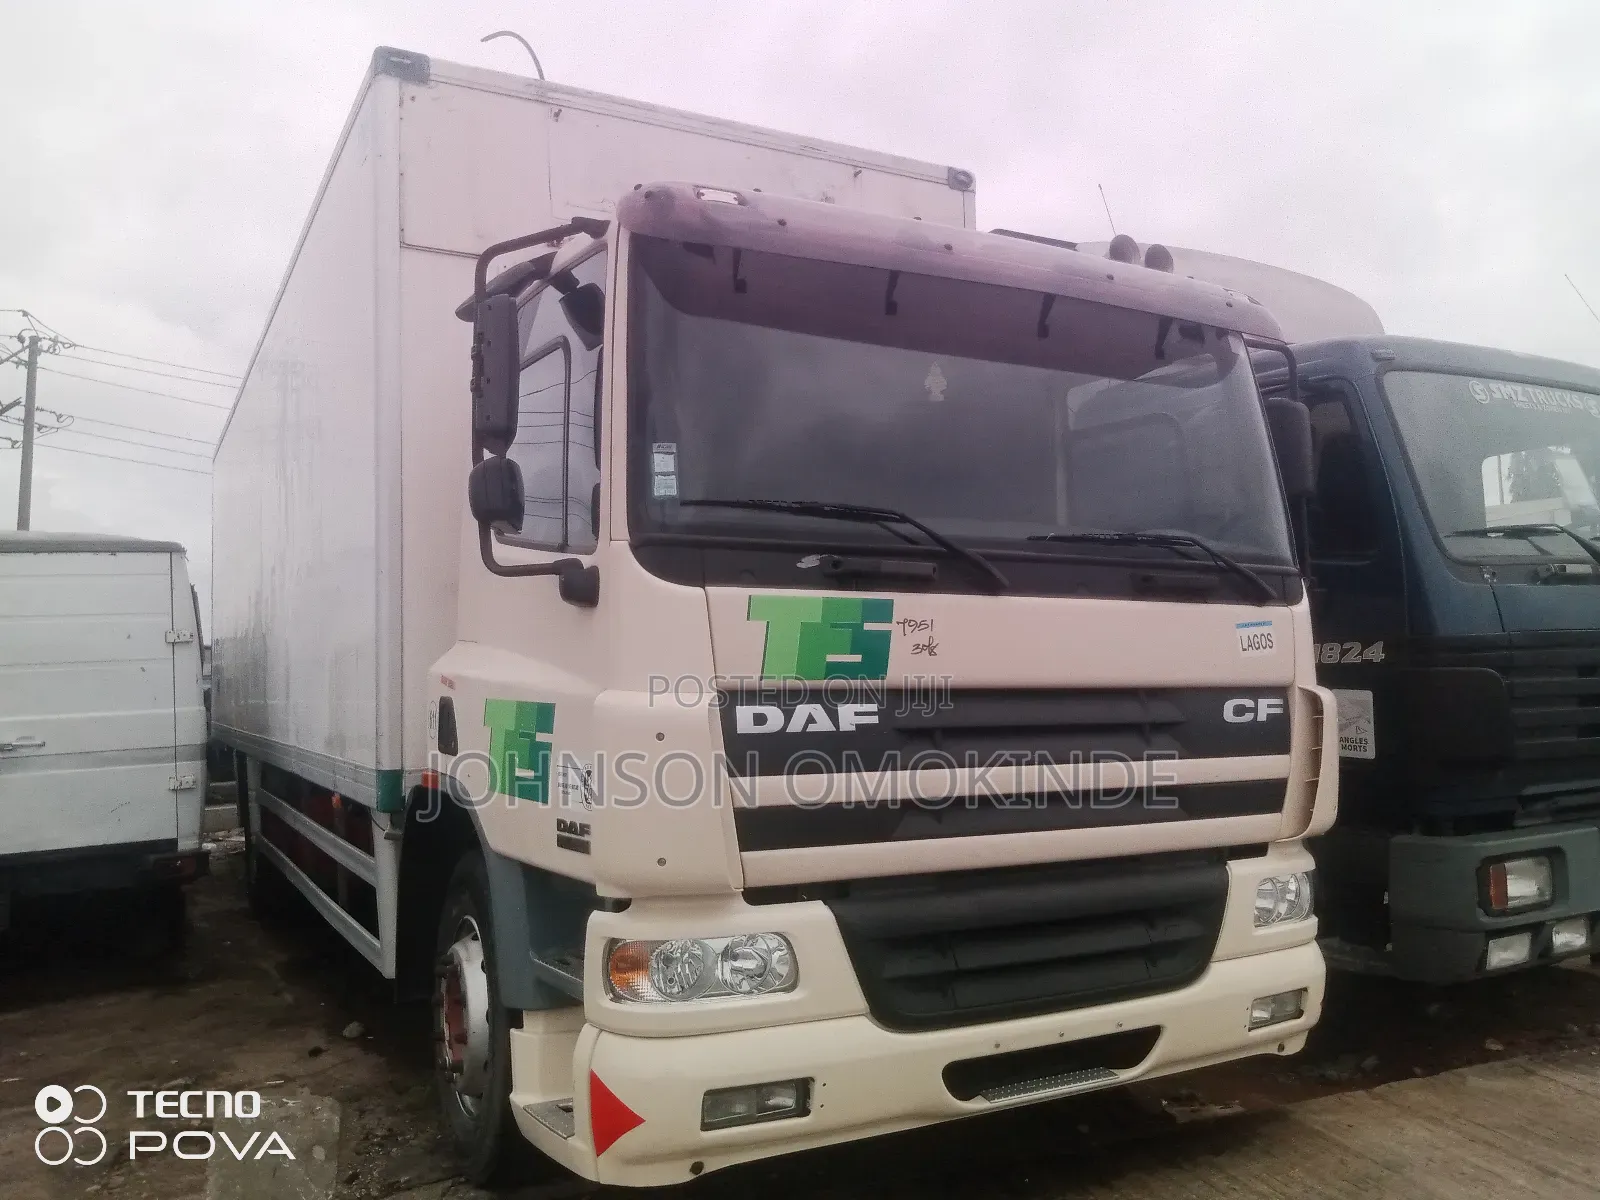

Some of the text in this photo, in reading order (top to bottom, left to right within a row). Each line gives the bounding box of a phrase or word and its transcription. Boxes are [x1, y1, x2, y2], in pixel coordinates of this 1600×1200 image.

[1525, 387, 1583, 409] TRUCKS
[1240, 632, 1274, 651] LAGOS
[1313, 641, 1385, 664] 1824
[736, 703, 879, 734] DAF
[1223, 698, 1284, 723] CF
[1339, 736, 1369, 745] ANGLES
[1341, 744, 1368, 752] MORTS
[557, 818, 591, 837] DAF
